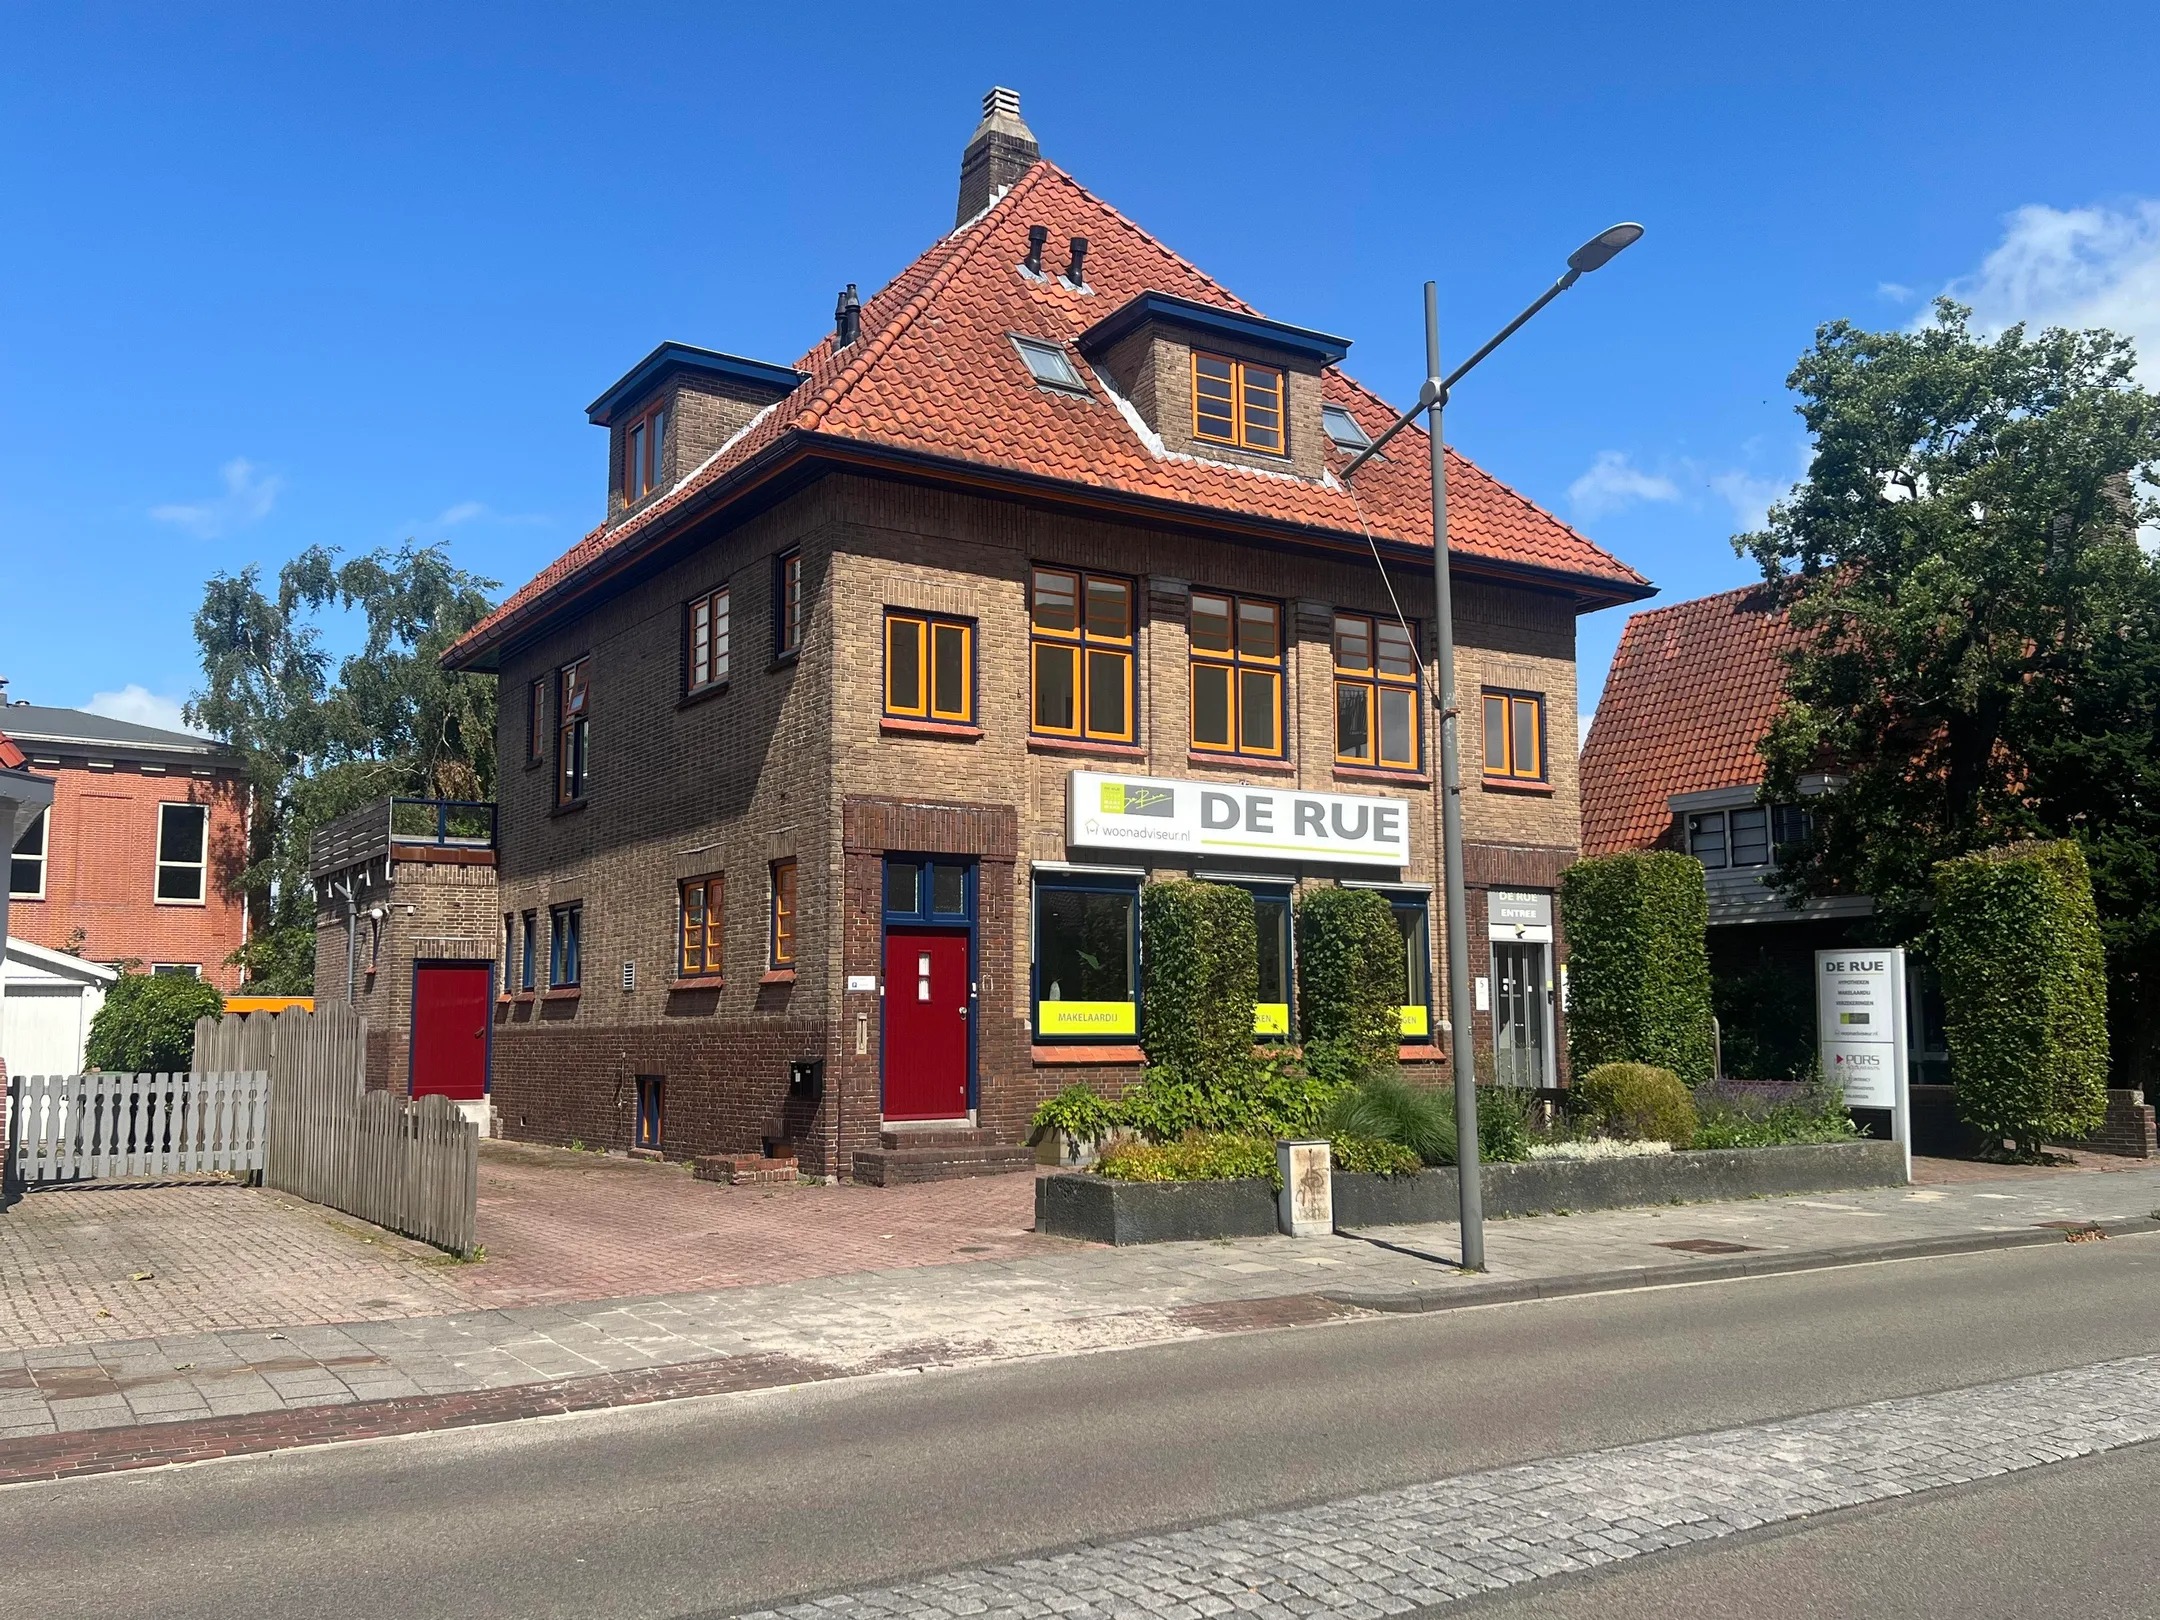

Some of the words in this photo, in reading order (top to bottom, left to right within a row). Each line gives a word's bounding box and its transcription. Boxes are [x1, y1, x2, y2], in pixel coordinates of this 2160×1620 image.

[1200, 791, 1274, 834] DE
[1294, 799, 1400, 844] RUE
[1102, 826, 1191, 841] woonadviseur.nl
[1499, 891, 1515, 901] DE
[1516, 893, 1538, 902] RUE
[1501, 908, 1537, 918] ENTREE
[1825, 961, 1845, 972] DE
[1849, 961, 1884, 972] RUE
[1058, 1013, 1118, 1022] MAKELAARDIJ
[1845, 1054, 1880, 1066] PORS
